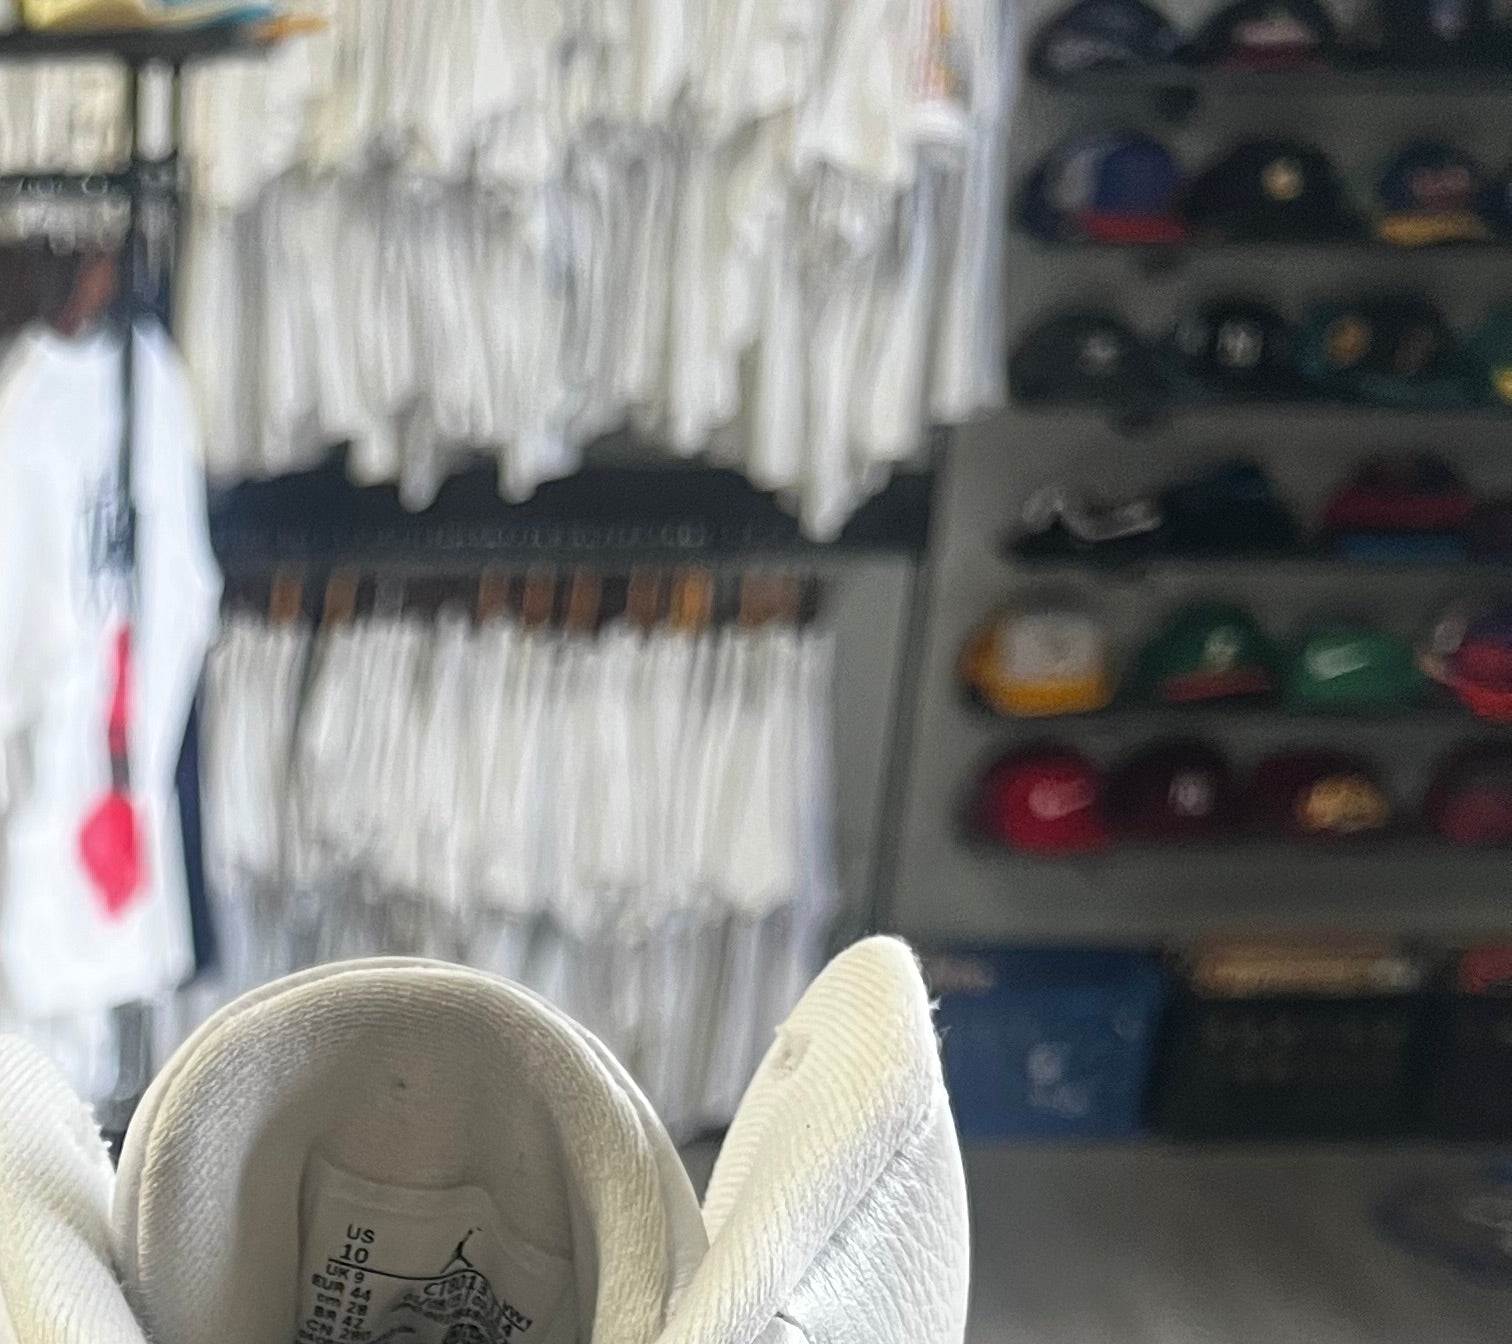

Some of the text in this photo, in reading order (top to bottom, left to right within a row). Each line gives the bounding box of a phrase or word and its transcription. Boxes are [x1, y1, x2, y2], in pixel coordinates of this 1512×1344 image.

[346, 1223, 375, 1244] US
[339, 1243, 369, 1264] 10
[326, 1263, 365, 1284] UK 9
[311, 1273, 372, 1302] EUR 44
